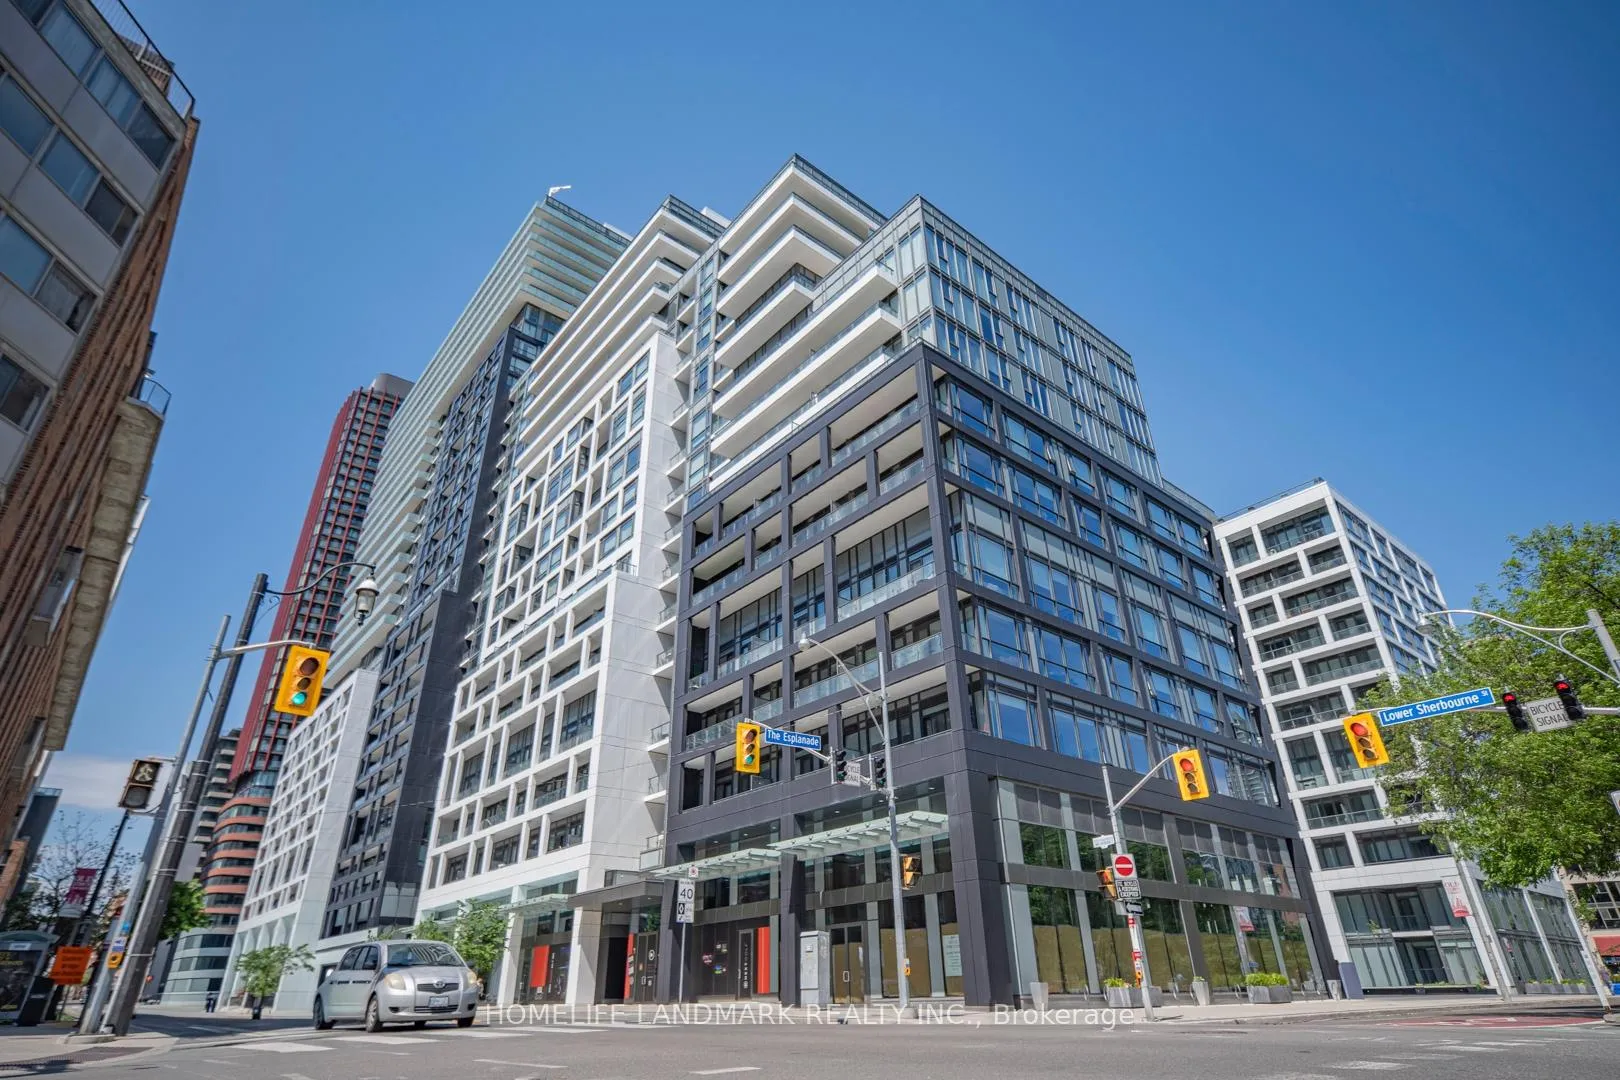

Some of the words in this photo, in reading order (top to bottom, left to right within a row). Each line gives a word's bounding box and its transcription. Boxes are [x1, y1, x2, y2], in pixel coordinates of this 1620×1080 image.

[1382, 708, 1414, 722] Lower
[1415, 694, 1480, 715] Sherbourne
[1529, 700, 1565, 716] BICYCLE
[1536, 713, 1569, 727] SIGNAL
[767, 729, 781, 739] The
[783, 731, 819, 746] Esplanade
[680, 888, 693, 900] 40
